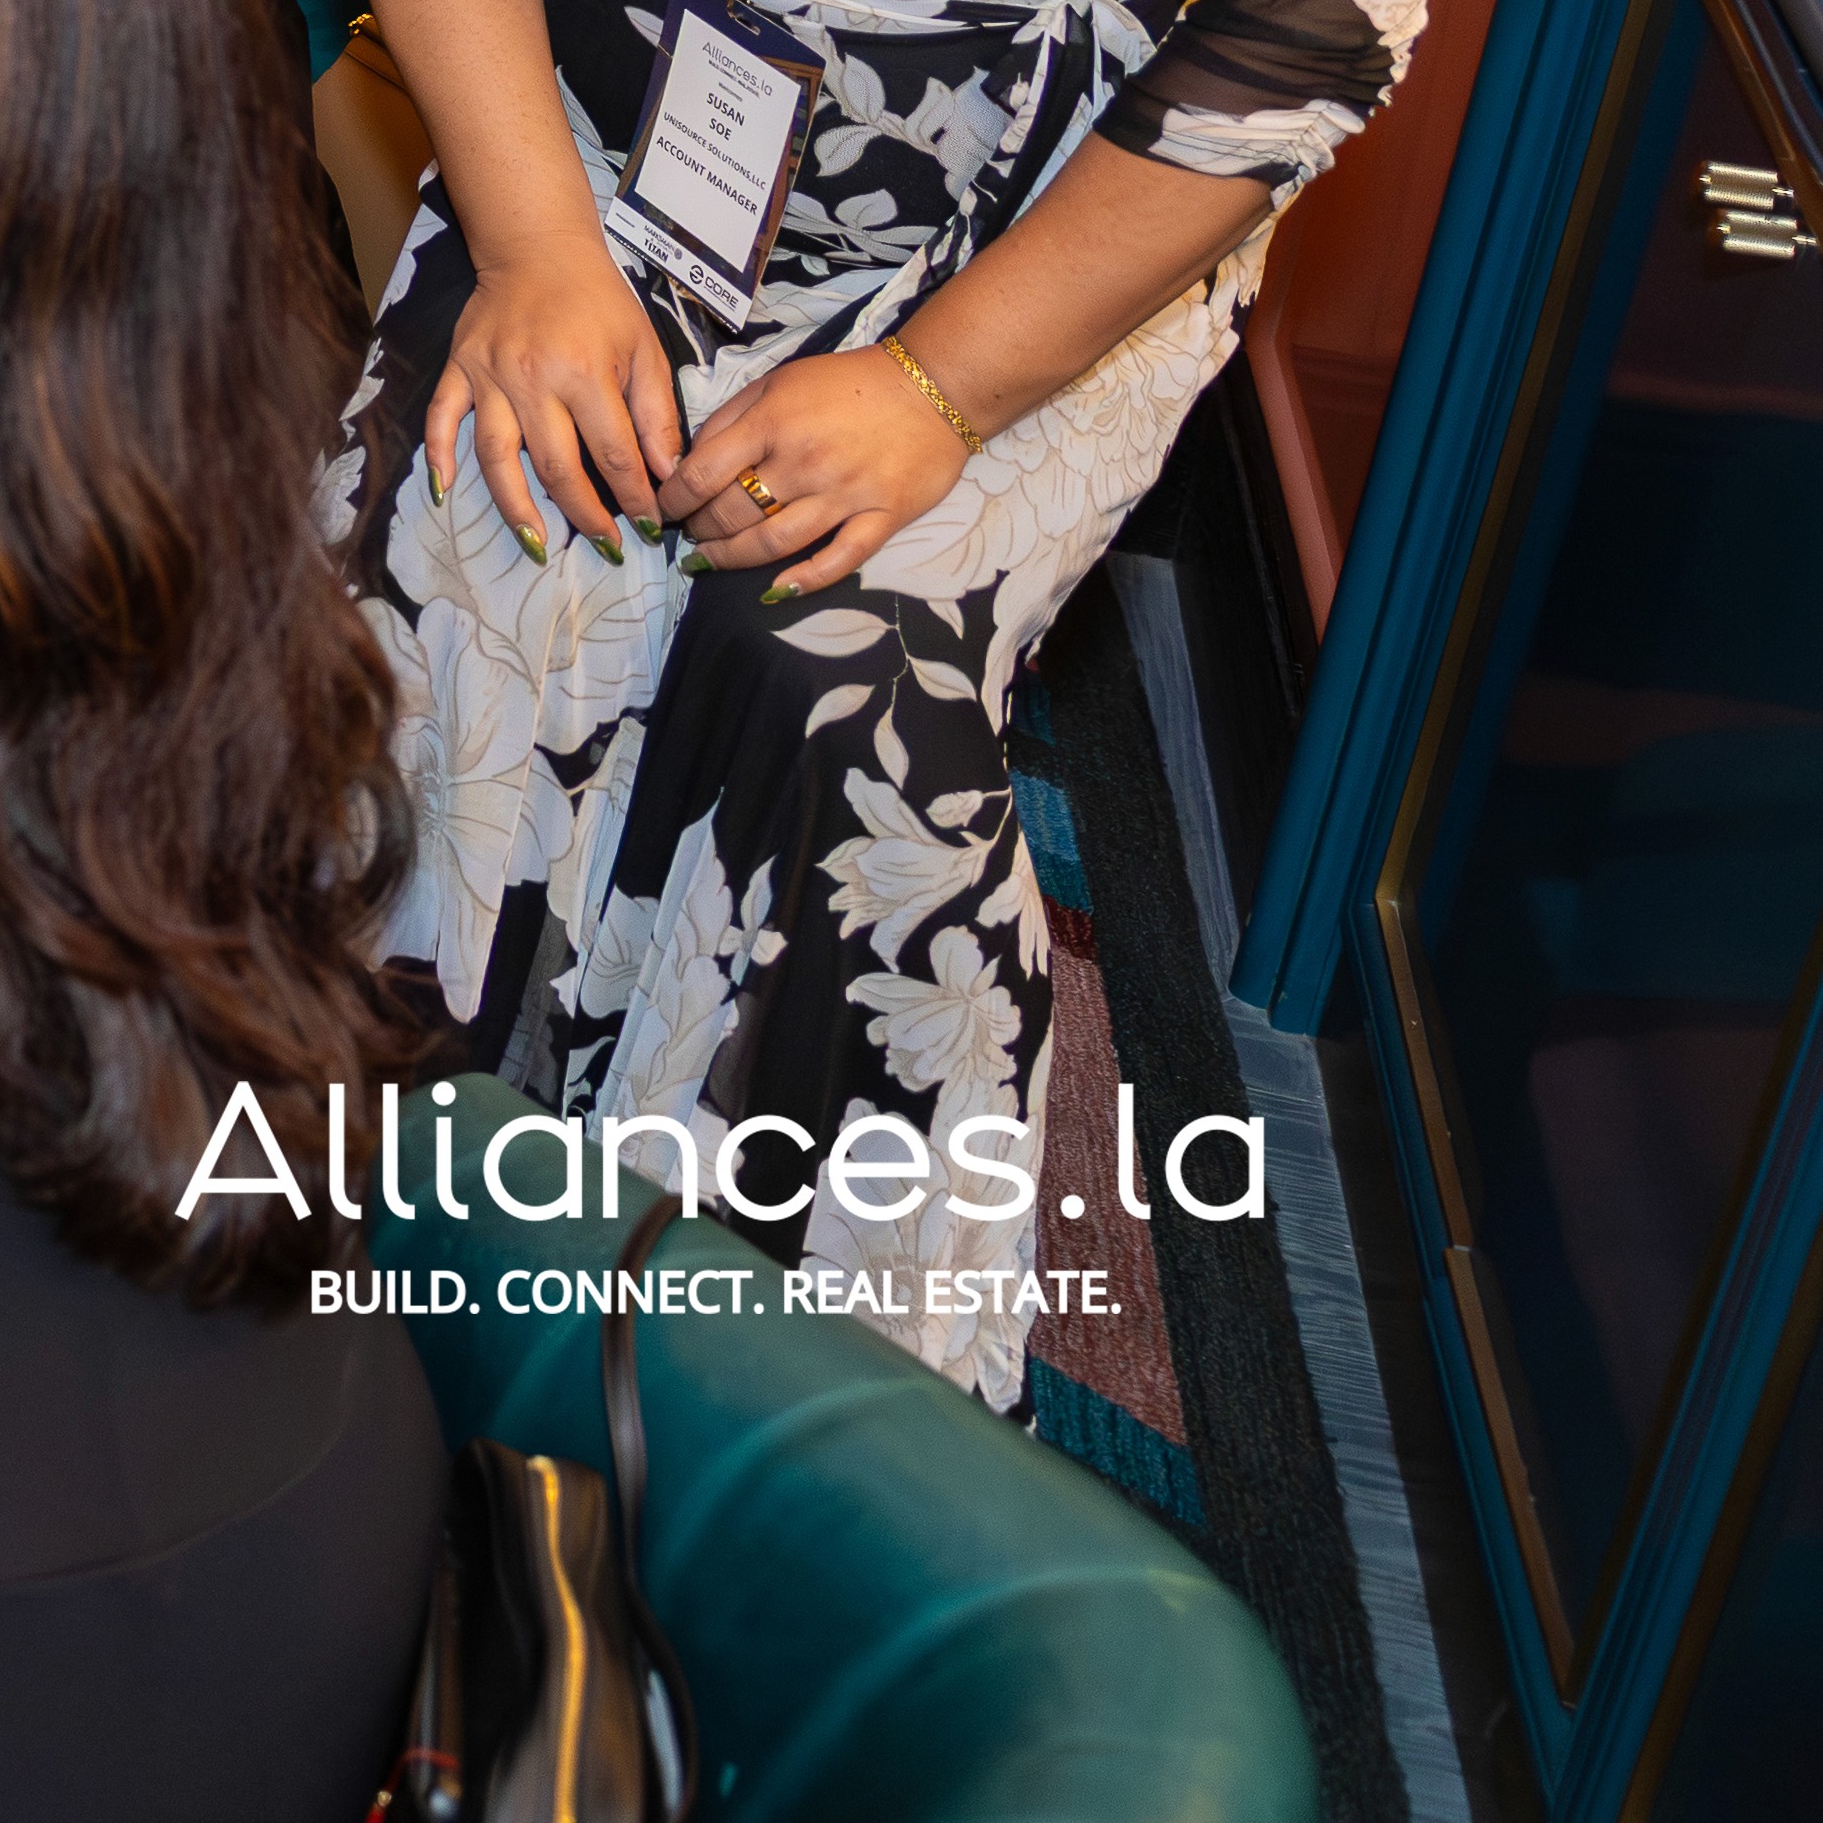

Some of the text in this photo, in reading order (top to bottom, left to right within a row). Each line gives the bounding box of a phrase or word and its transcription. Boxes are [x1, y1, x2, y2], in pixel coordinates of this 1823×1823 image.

[701, 39, 774, 97] Alliances.la
[706, 91, 745, 127] SUSAN
[662, 110, 707, 148] UNISOURCE
[708, 117, 732, 141] SOE
[656, 134, 758, 216] ACCOUNT MANAGER
[643, 236, 669, 263] TITAN
[703, 275, 739, 309] CORE
